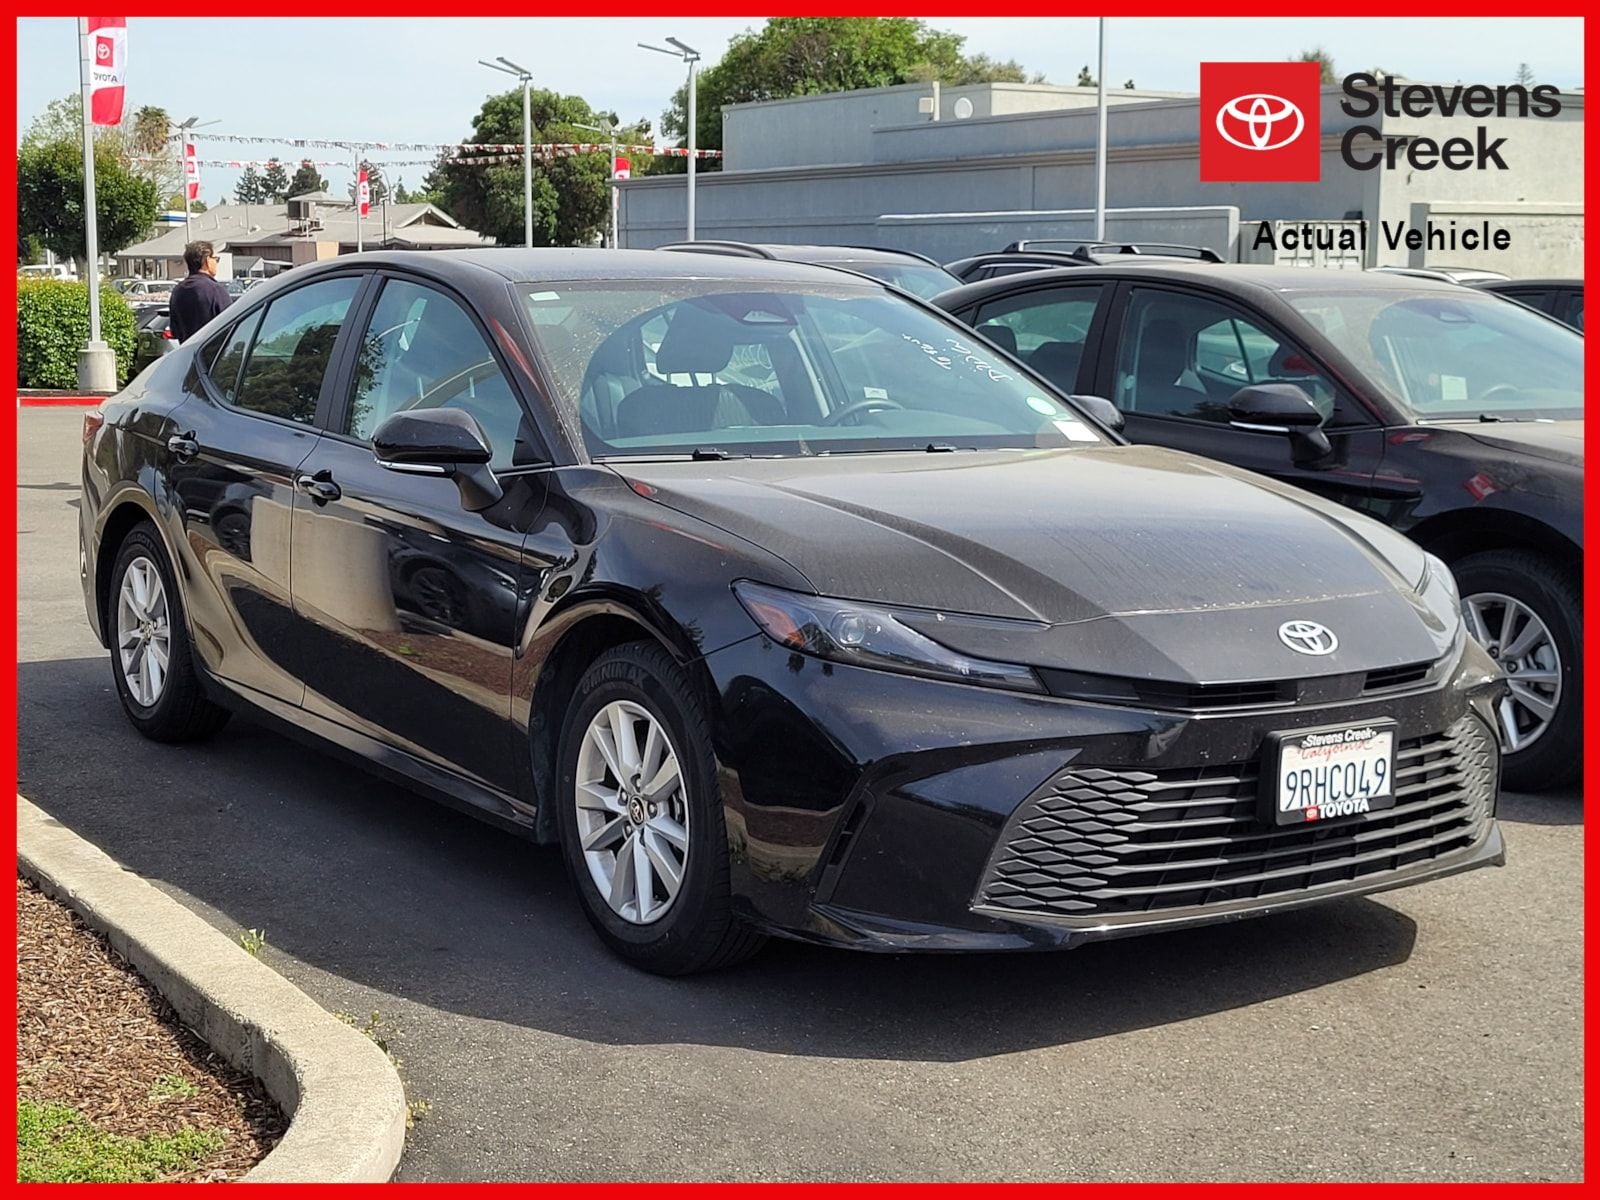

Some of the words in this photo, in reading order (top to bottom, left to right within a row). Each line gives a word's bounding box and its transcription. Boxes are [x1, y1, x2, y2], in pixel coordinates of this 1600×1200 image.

[1305, 733, 1344, 748] Stevens
[1345, 728, 1373, 742] Creek
[1285, 758, 1387, 810] 9RHC049
[1318, 798, 1370, 819] TOYOTA
